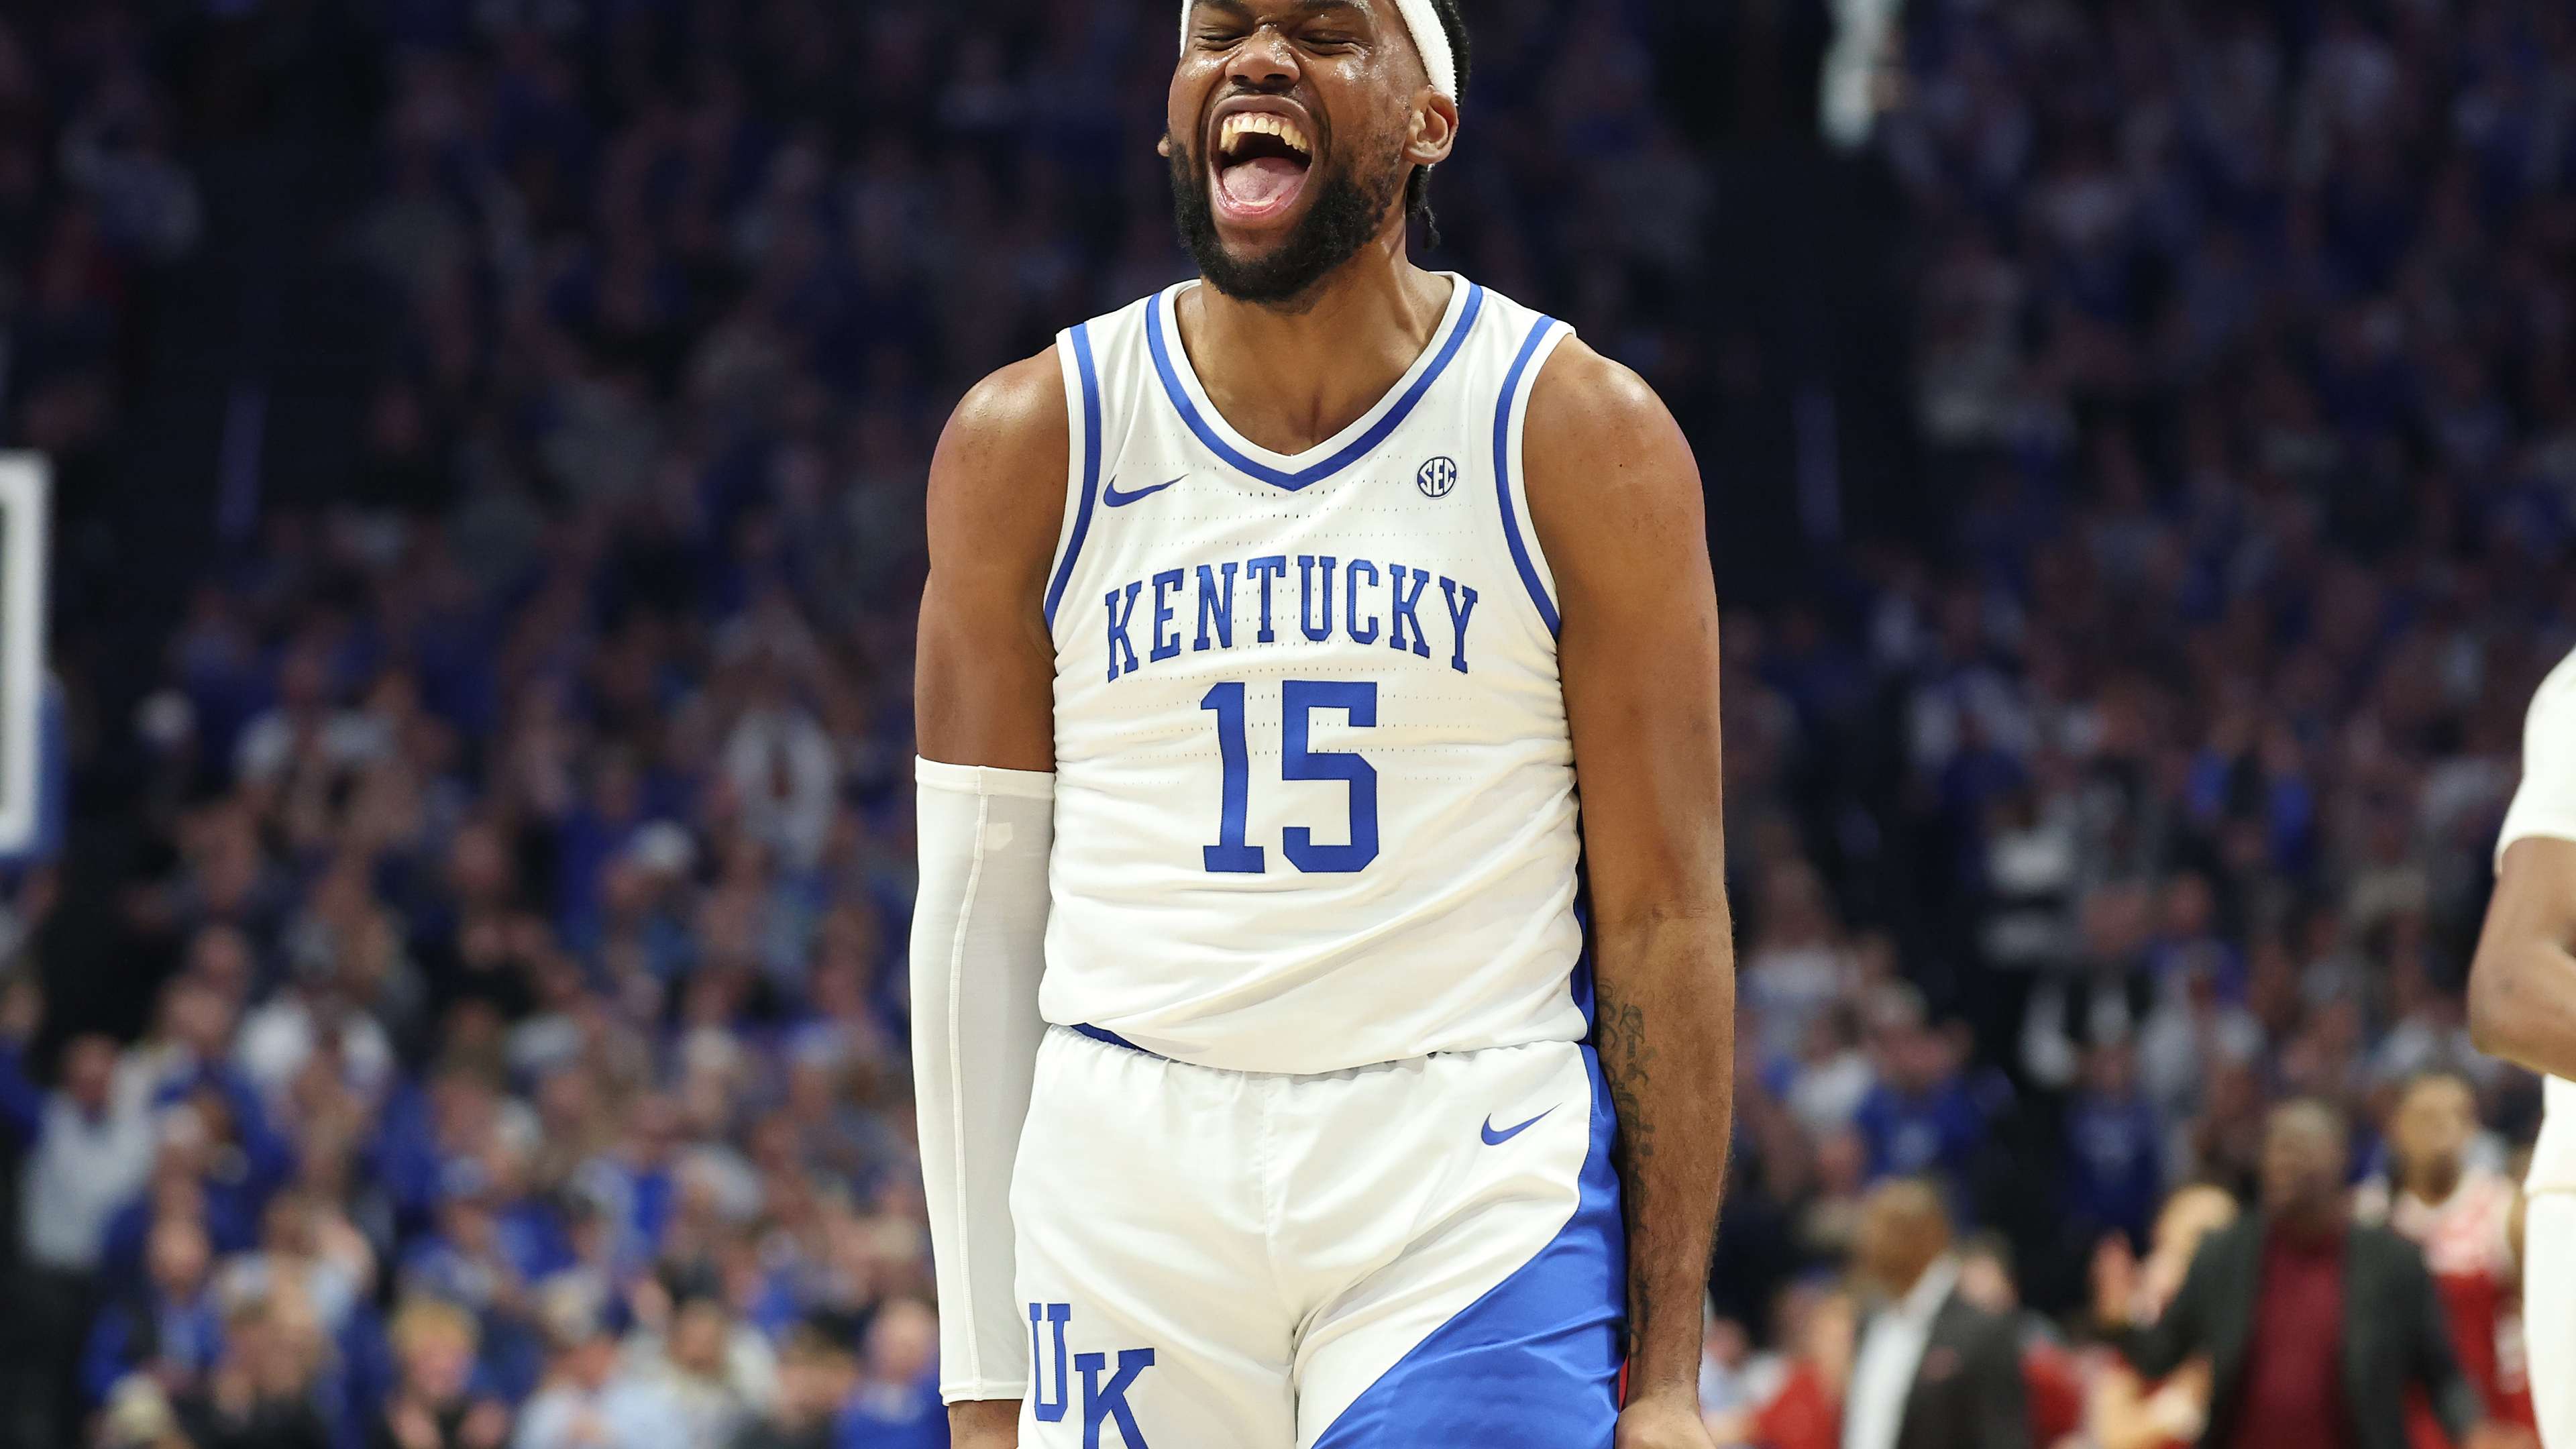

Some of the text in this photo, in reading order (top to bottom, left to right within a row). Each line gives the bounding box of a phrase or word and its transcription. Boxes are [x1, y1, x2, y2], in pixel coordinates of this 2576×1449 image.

[1417, 456, 1457, 497] SEC
[1104, 555, 1479, 682] KENTUCKY
[1200, 680, 1379, 873] 15
[1029, 1302, 1155, 1449] UK
